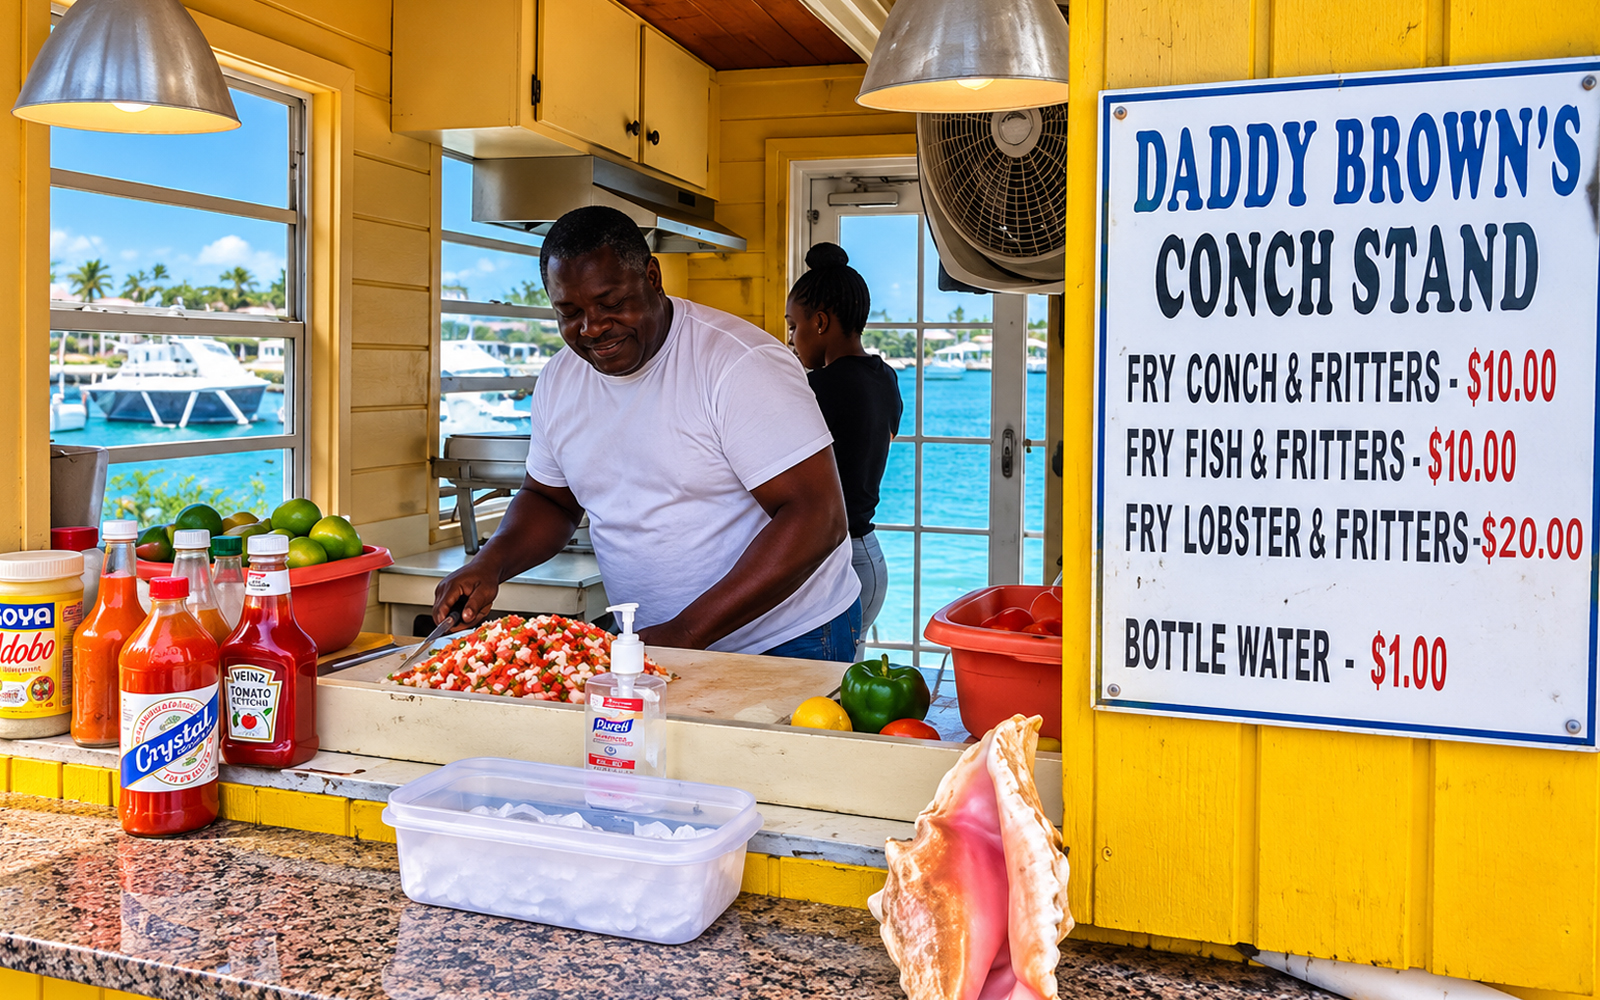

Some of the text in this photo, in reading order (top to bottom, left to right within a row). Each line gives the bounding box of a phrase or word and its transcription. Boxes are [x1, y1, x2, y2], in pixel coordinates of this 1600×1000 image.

[1134, 104, 1580, 213] DADDY BROWN'S
[1156, 221, 1539, 319] CONCH STAND
[1127, 354, 1176, 403] FRY
[1186, 352, 1278, 404] CONCH
[1284, 352, 1303, 404] &
[1310, 350, 1440, 403] FRITTERS
[1467, 347, 1557, 407] $10.00
[1126, 428, 1175, 477] FRY
[1185, 428, 1243, 479] FISH
[1250, 428, 1268, 480] &
[1275, 429, 1405, 482] FRITTERS
[1427, 426, 1516, 486] $10.00
[1125, 503, 1173, 553] FRY
[1184, 504, 1301, 558] LOBSTER
[1309, 507, 1326, 560] &
[0, 607, 51, 627] OYA
[1125, 617, 1226, 675] BOTTLE
[1237, 624, 1330, 683] WATER
[1370, 630, 1448, 692] $1.00
[230, 685, 272, 699] TONATO
[135, 705, 213, 773] Crystal
